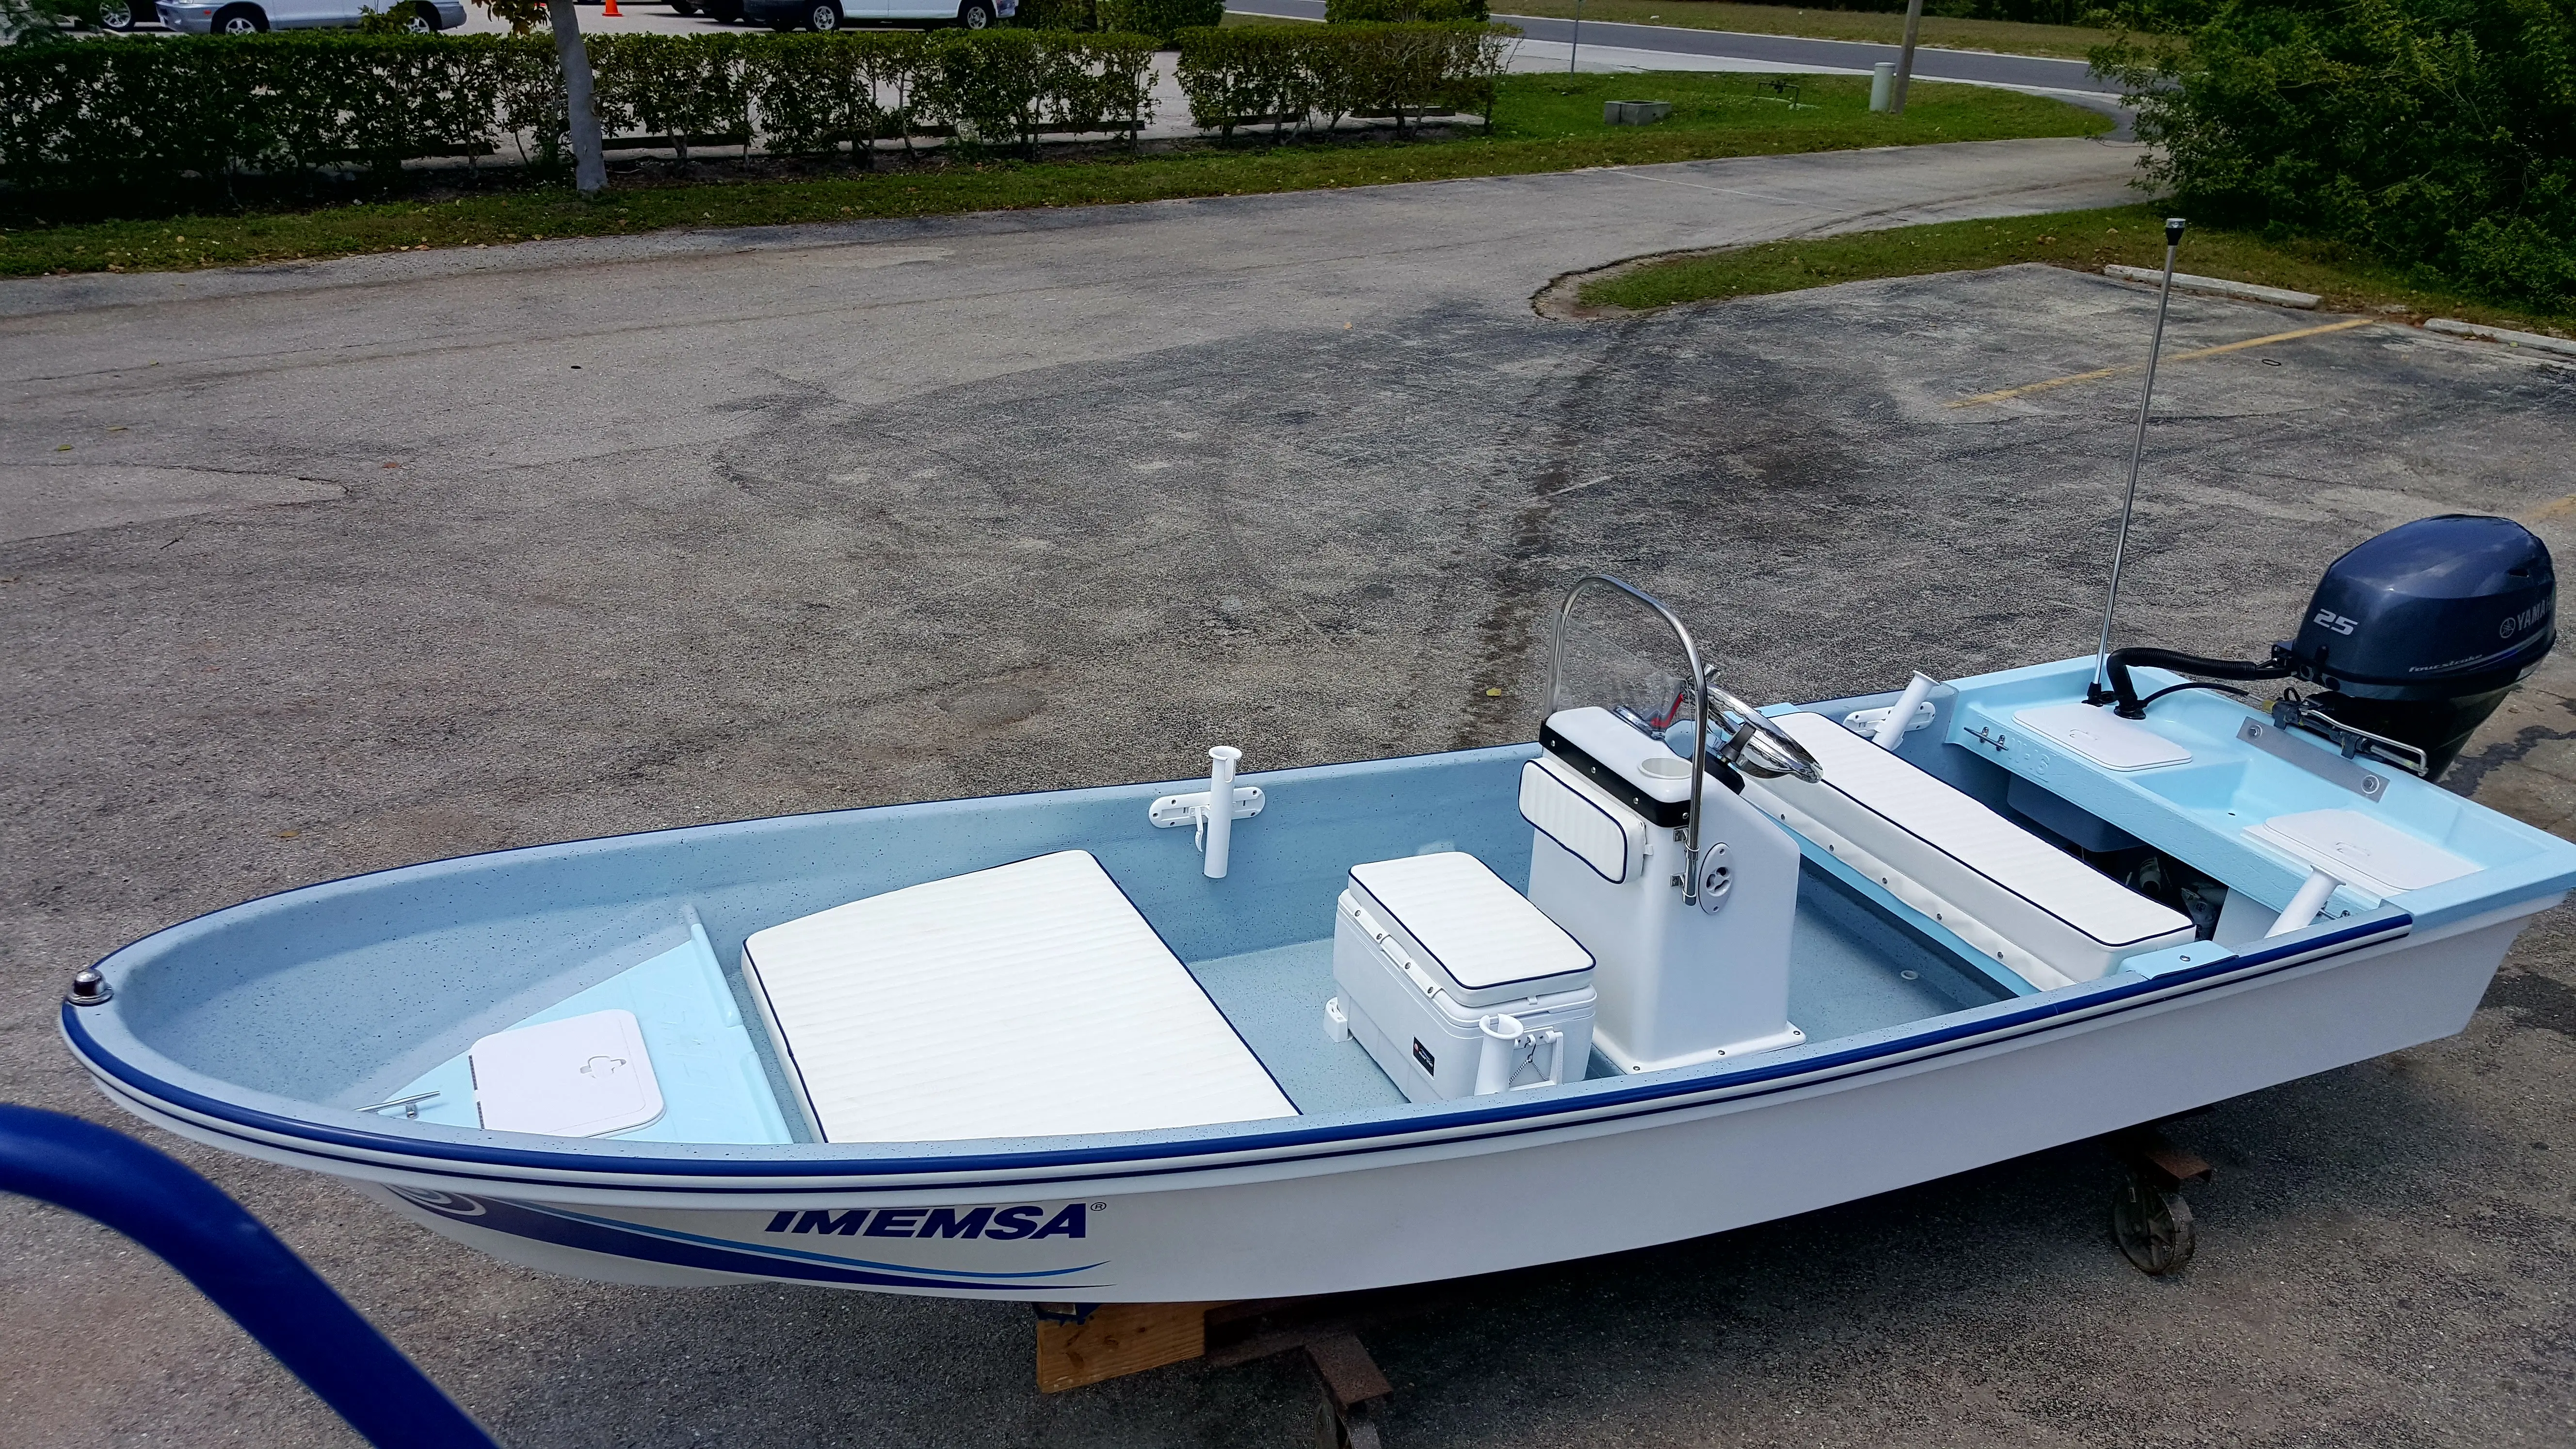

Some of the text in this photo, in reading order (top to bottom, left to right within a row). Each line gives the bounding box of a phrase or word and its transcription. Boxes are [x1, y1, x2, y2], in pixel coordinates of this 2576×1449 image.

[2313, 608, 2358, 635] 25
[2517, 596, 2552, 631] YAMAH
[764, 1203, 1086, 1240] IMEMSA
